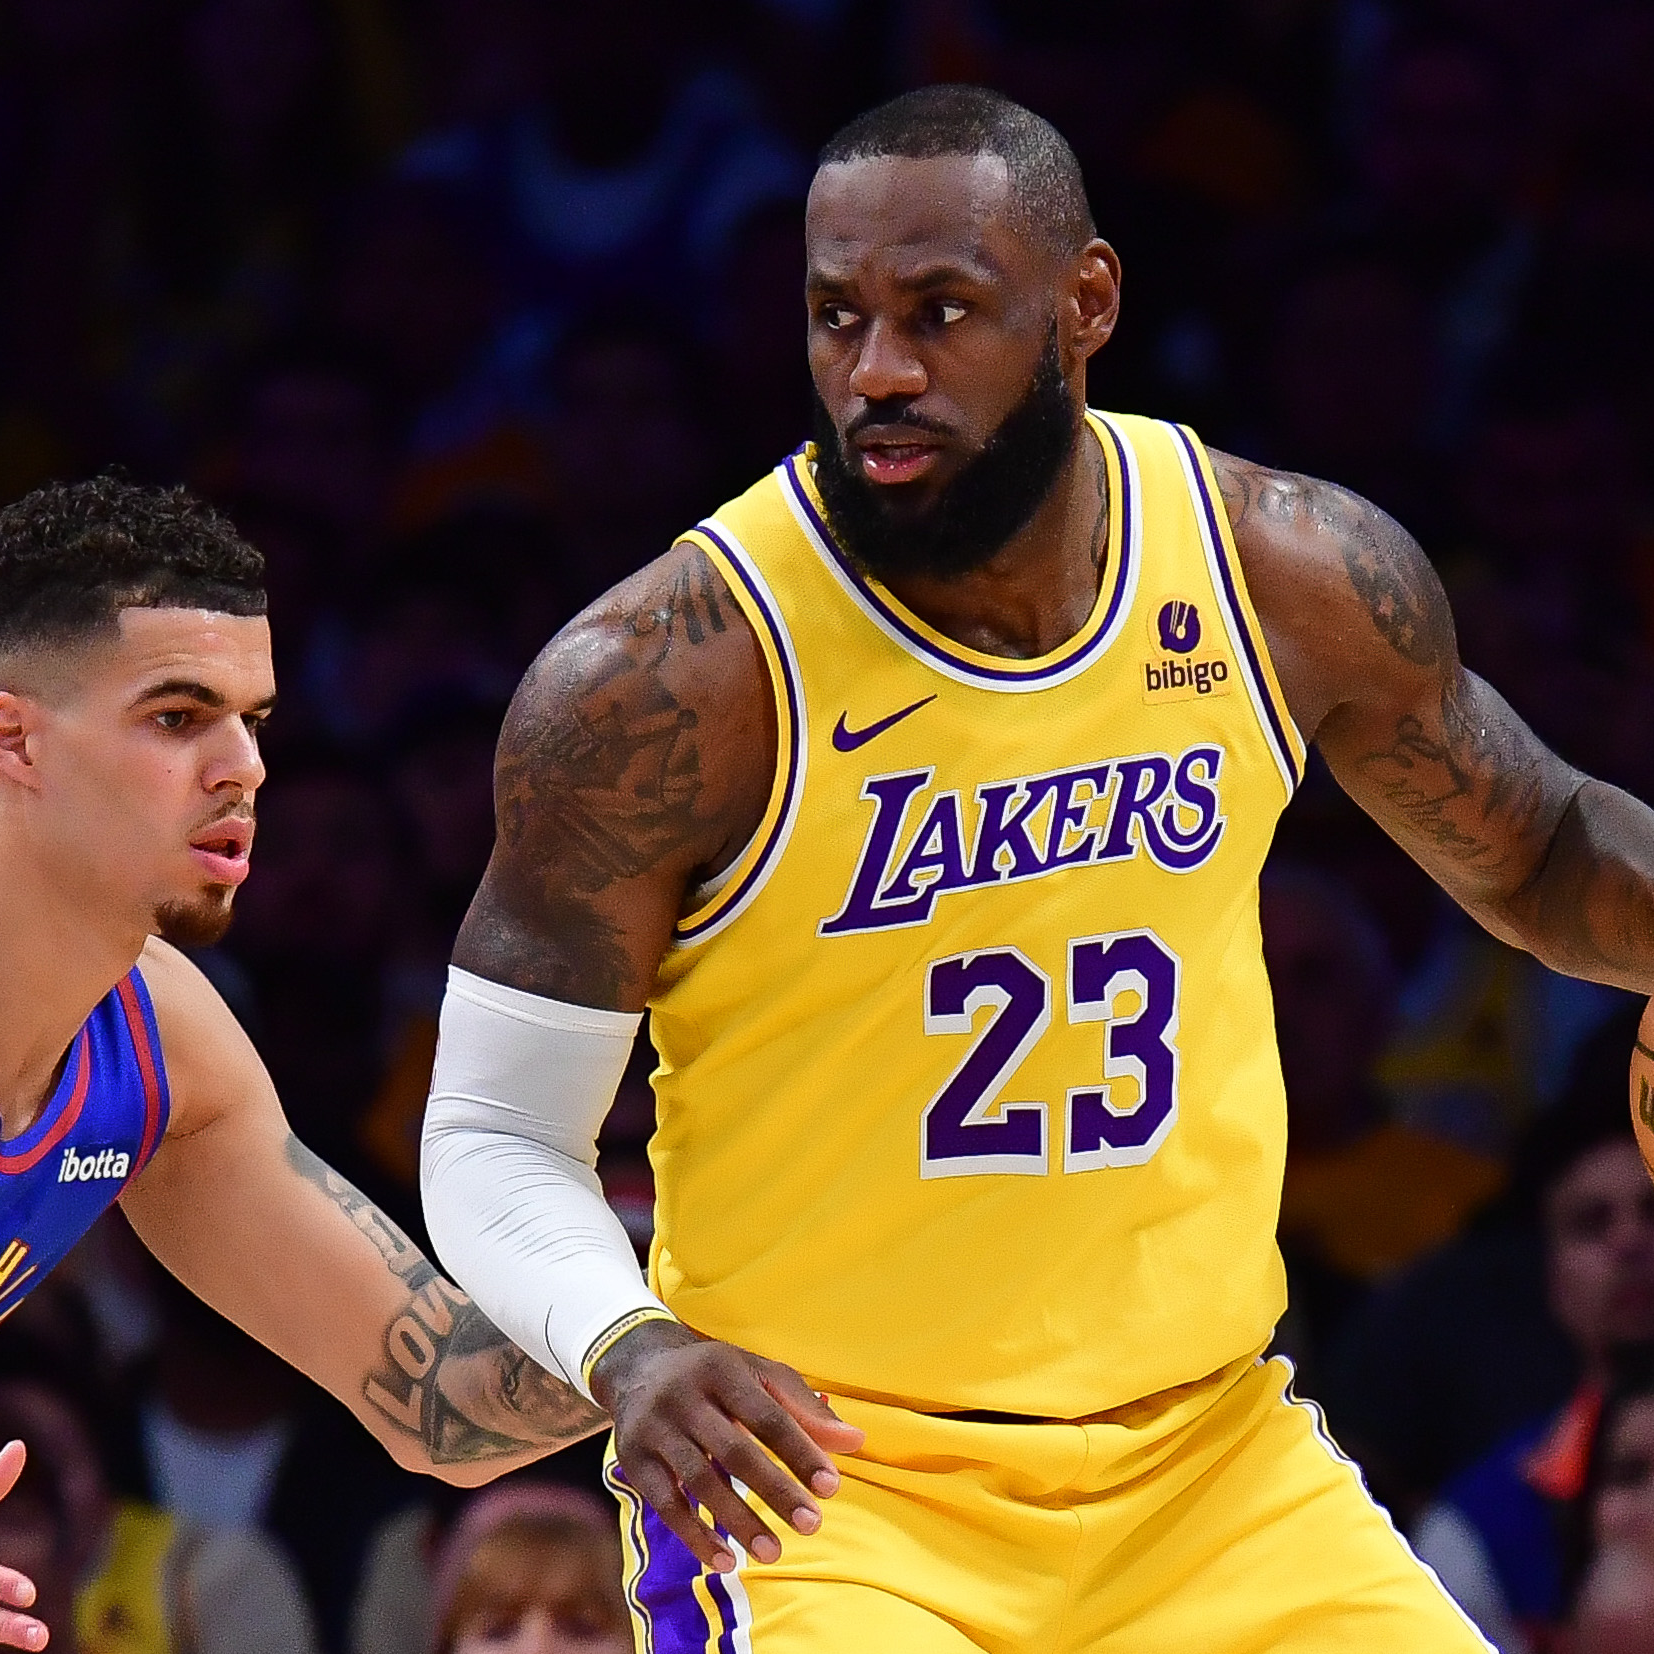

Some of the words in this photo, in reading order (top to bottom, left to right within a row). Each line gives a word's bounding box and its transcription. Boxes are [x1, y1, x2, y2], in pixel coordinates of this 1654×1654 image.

[1145, 657, 1228, 694] bibigo
[817, 742, 1228, 936] LAKERS
[921, 928, 1182, 1178] 23
[57, 1146, 130, 1183] ibotta
[587, 1315, 639, 1363] PROMISE
